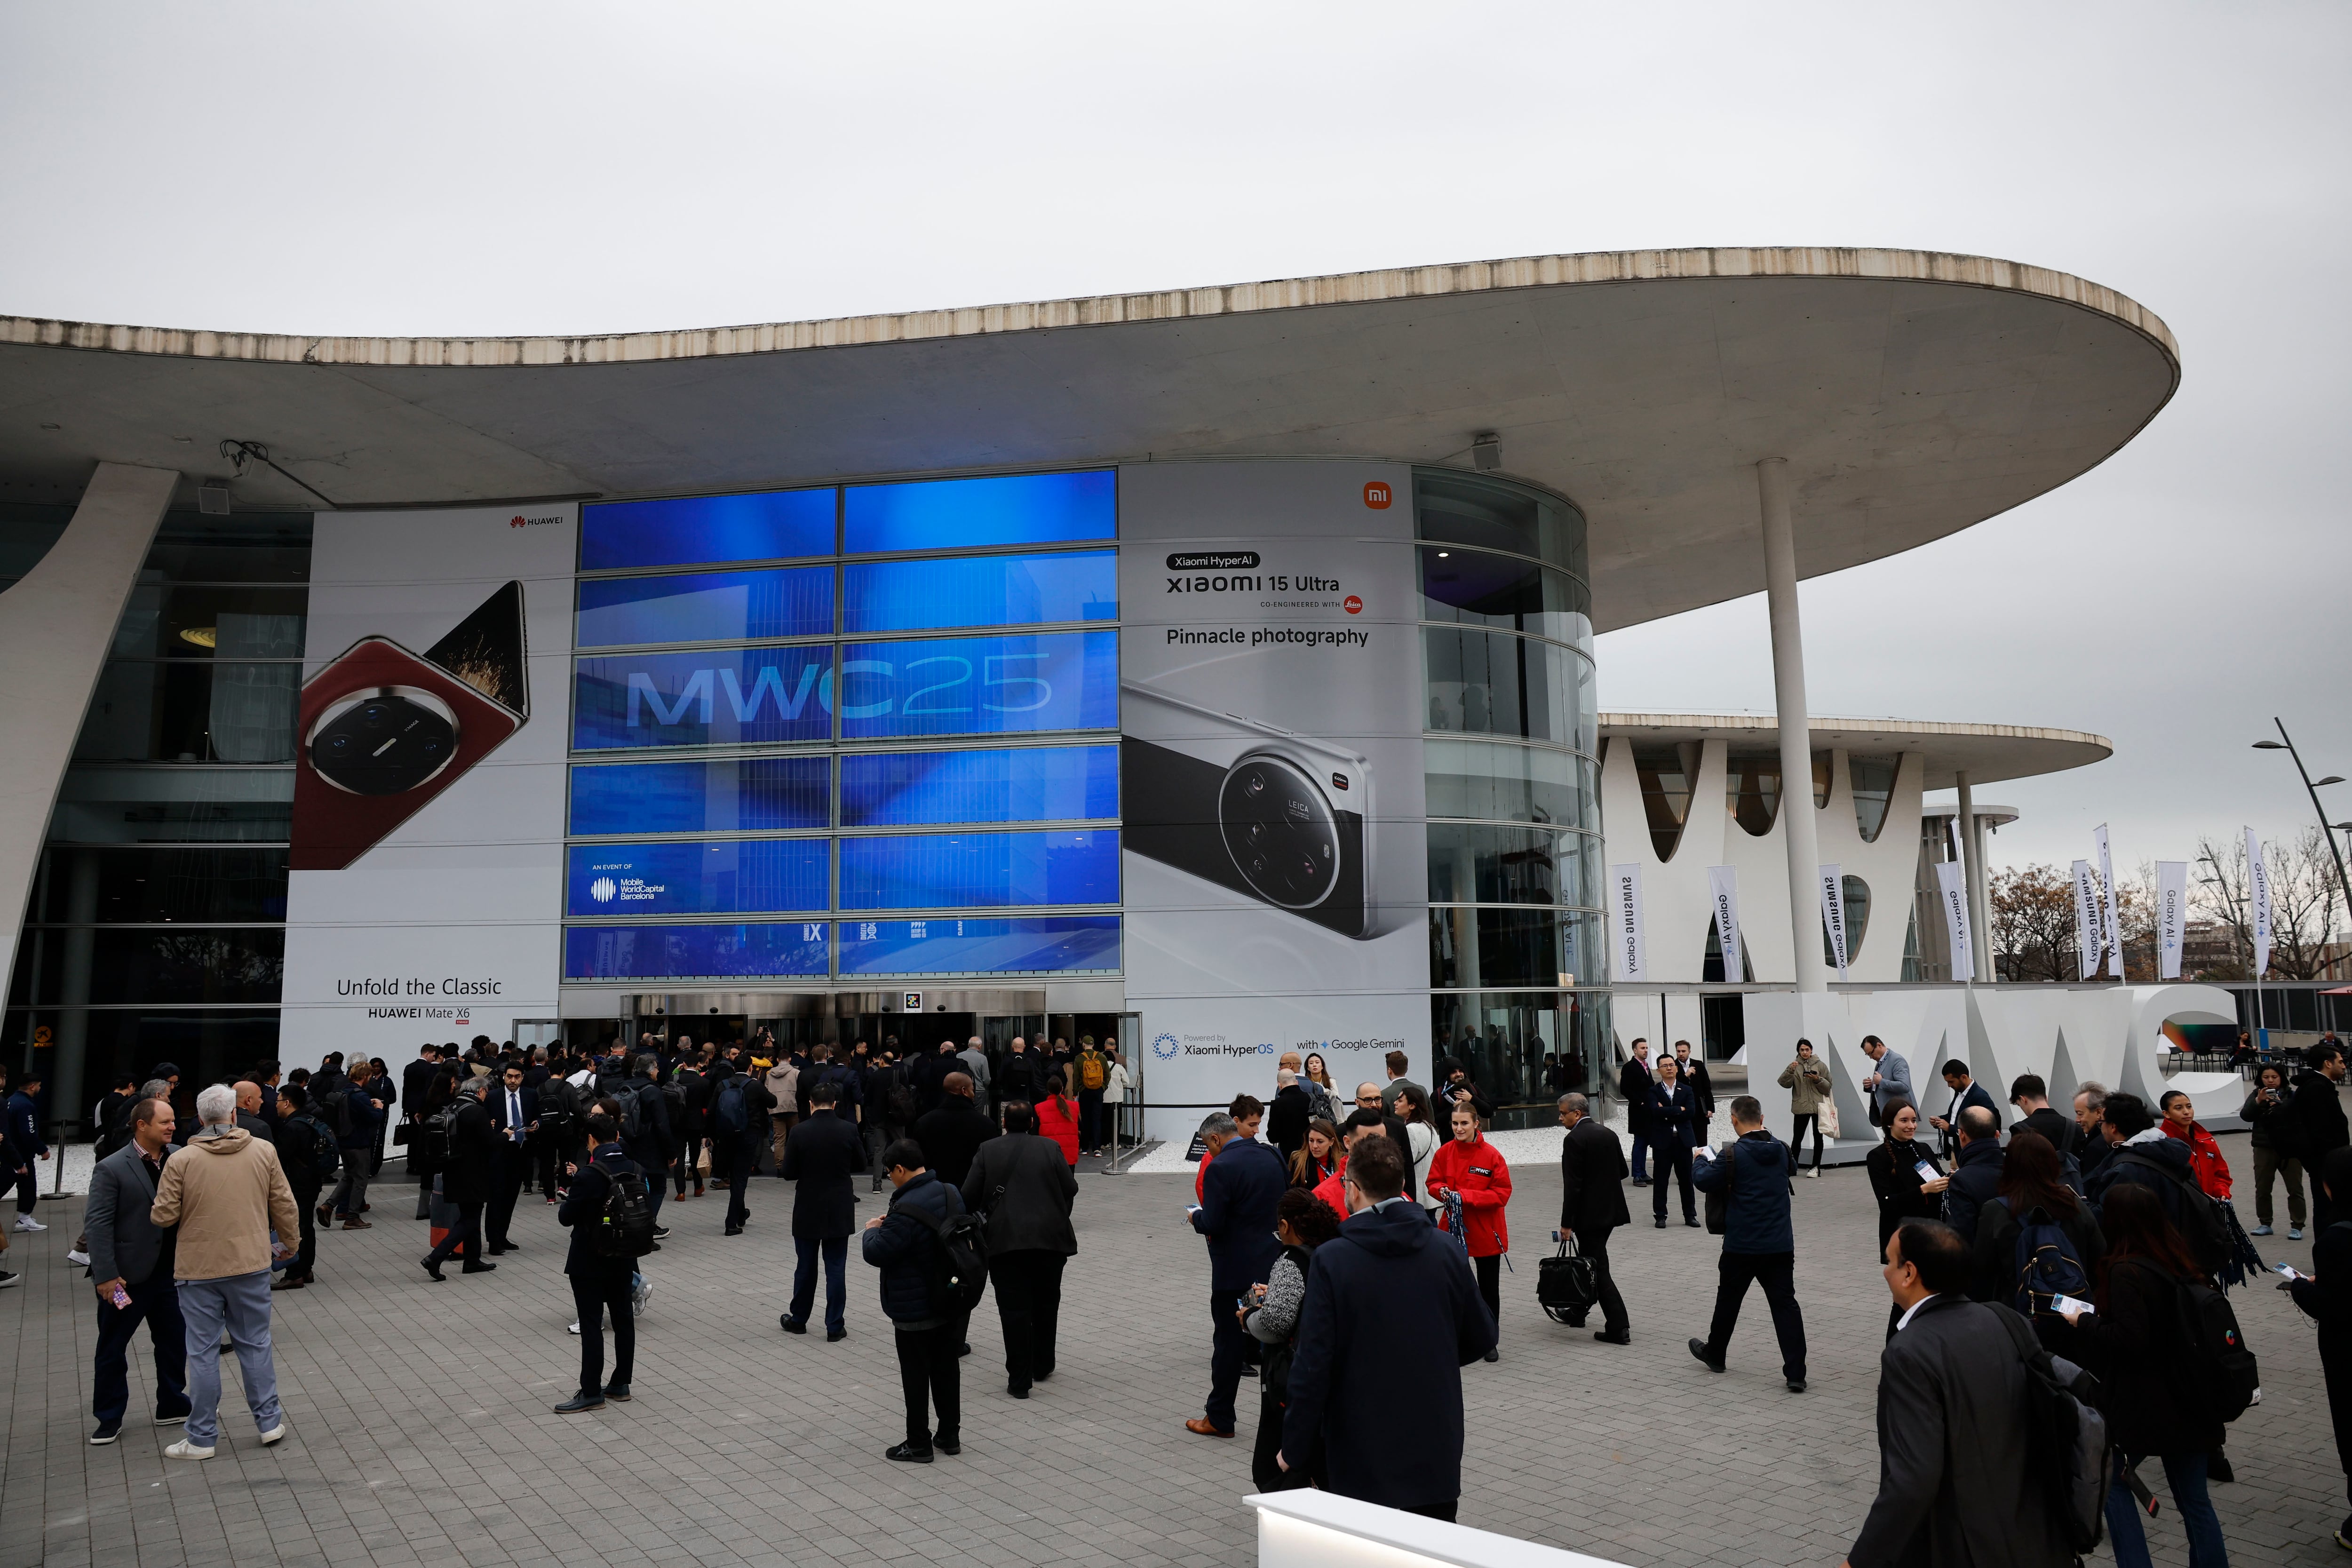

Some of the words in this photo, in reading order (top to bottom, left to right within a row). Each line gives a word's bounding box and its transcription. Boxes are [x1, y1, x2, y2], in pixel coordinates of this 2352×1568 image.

[527, 517, 563, 525] HUAWEI
[1175, 556, 1208, 566] Xiaomi
[1210, 555, 1252, 567] HyperAI
[1269, 576, 1288, 591] 15
[1295, 576, 1339, 591] Ultra
[1345, 600, 1361, 609] Leica
[1167, 628, 1245, 645] Pinnacle
[1252, 628, 1369, 648] photography
[626, 653, 1052, 727] MWC25
[1288, 799, 1309, 813] LEICA
[2255, 863, 2266, 908] Galaxy
[2163, 890, 2176, 926] Galaxy
[2082, 871, 2098, 925] SAMSUNG
[2090, 927, 2102, 963] Galaxy
[2258, 911, 2265, 923] AI
[2166, 928, 2175, 937] AI
[338, 978, 398, 995] Unfold
[406, 978, 435, 995] the
[442, 978, 501, 995] Classic
[368, 1008, 421, 1018] HUAWEI
[426, 1008, 453, 1018] Mate
[456, 1008, 470, 1018] X6
[1217, 1034, 1226, 1043] by
[1296, 1040, 1318, 1050] with
[1332, 1039, 1368, 1051] Google
[1370, 1038, 1404, 1048] Gemini
[1184, 1044, 1220, 1055] Xiaomi
[1223, 1044, 1273, 1058] HyperOS
